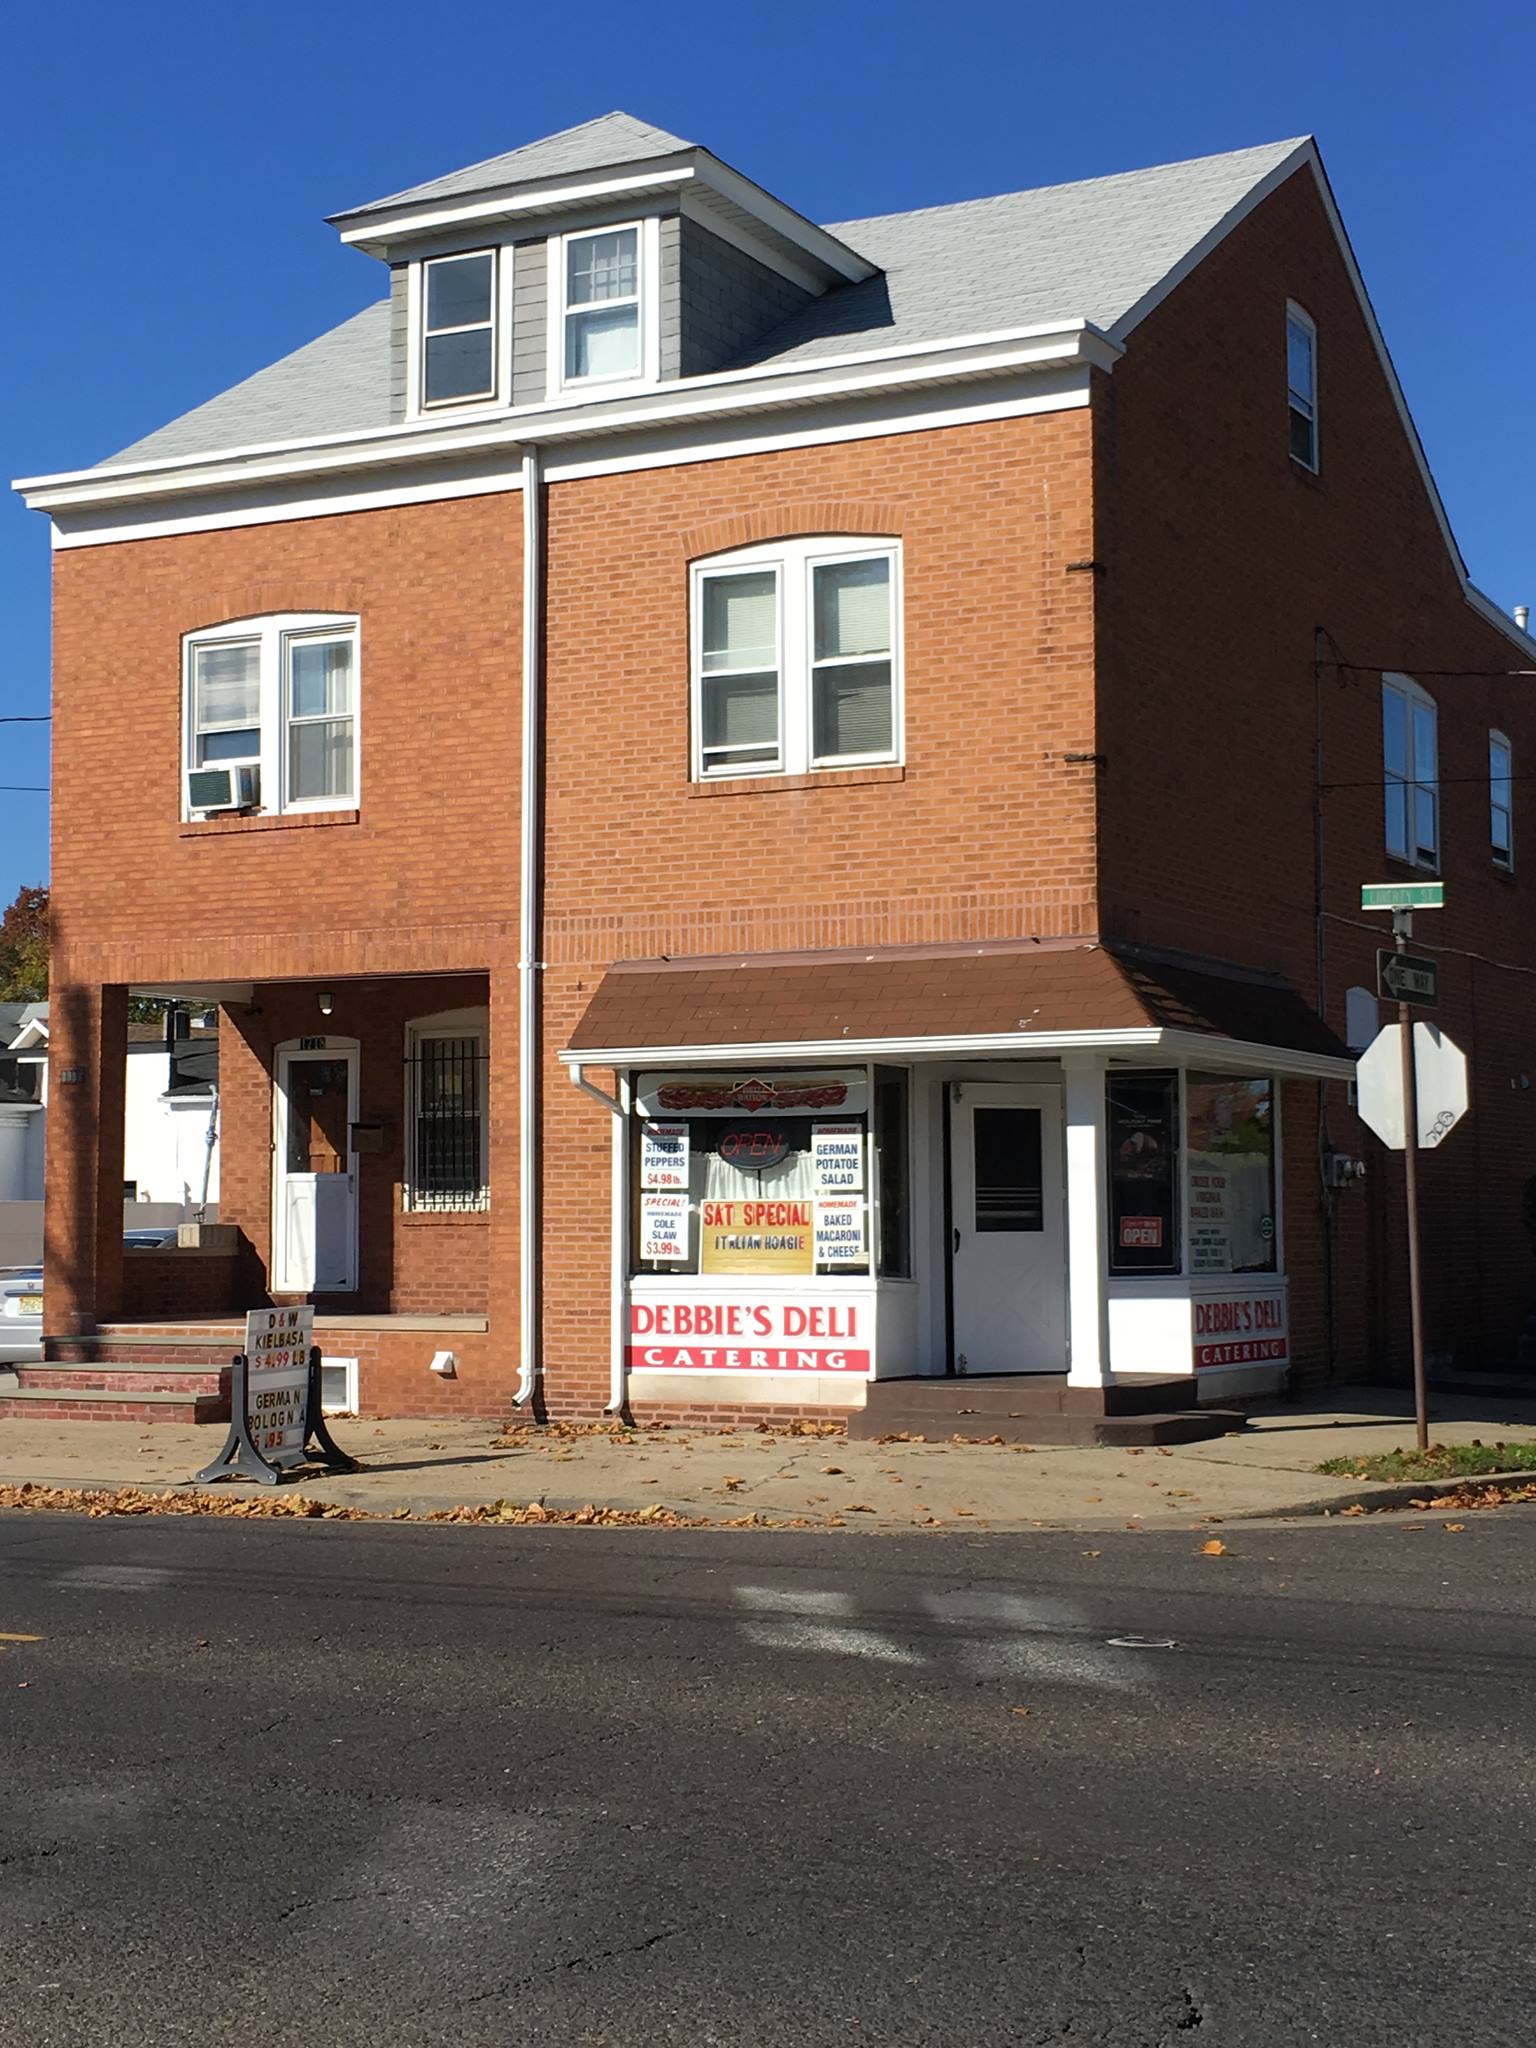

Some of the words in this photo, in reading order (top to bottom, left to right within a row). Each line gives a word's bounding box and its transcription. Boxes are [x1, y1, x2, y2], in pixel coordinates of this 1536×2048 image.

[1390, 967, 1405, 988] ONE
[1413, 973, 1429, 991] WAY
[645, 1142, 685, 1153] STUFFED
[720, 1132, 782, 1157] OPEN
[816, 1144, 858, 1155] GERMAN
[644, 1157, 685, 1167] PEPPERS
[816, 1158, 859, 1169] POTATOE
[647, 1173, 672, 1184] $4.98
[821, 1173, 854, 1184] SALAD
[644, 1197, 686, 1207] SPECIAL!
[817, 1200, 857, 1208] HOMEMADE
[704, 1203, 734, 1226] SAT
[743, 1203, 810, 1226] SPECIAL
[824, 1214, 852, 1226] BAKED
[654, 1219, 676, 1229] COLE
[652, 1230, 677, 1240] SLAW
[816, 1229, 861, 1241] MACARONI
[1123, 1228, 1158, 1244] OPEN
[646, 1240, 672, 1254] $3.99
[715, 1236, 761, 1250] ITALIAN
[765, 1236, 805, 1250] HOAGIE
[818, 1246, 825, 1257] &
[269, 1313, 276, 1329] D
[289, 1311, 298, 1327] W
[631, 1304, 773, 1337] DEBBIE'S
[783, 1306, 857, 1338] DELI
[1196, 1302, 1251, 1333] DEBBIE'S
[1254, 1299, 1281, 1329] DELI
[255, 1331, 304, 1349] KIELBASA
[293, 1350, 305, 1366] LB
[644, 1348, 847, 1369] CATERING
[1202, 1341, 1280, 1363] CATERING
[256, 1390, 300, 1410] GERMAN
